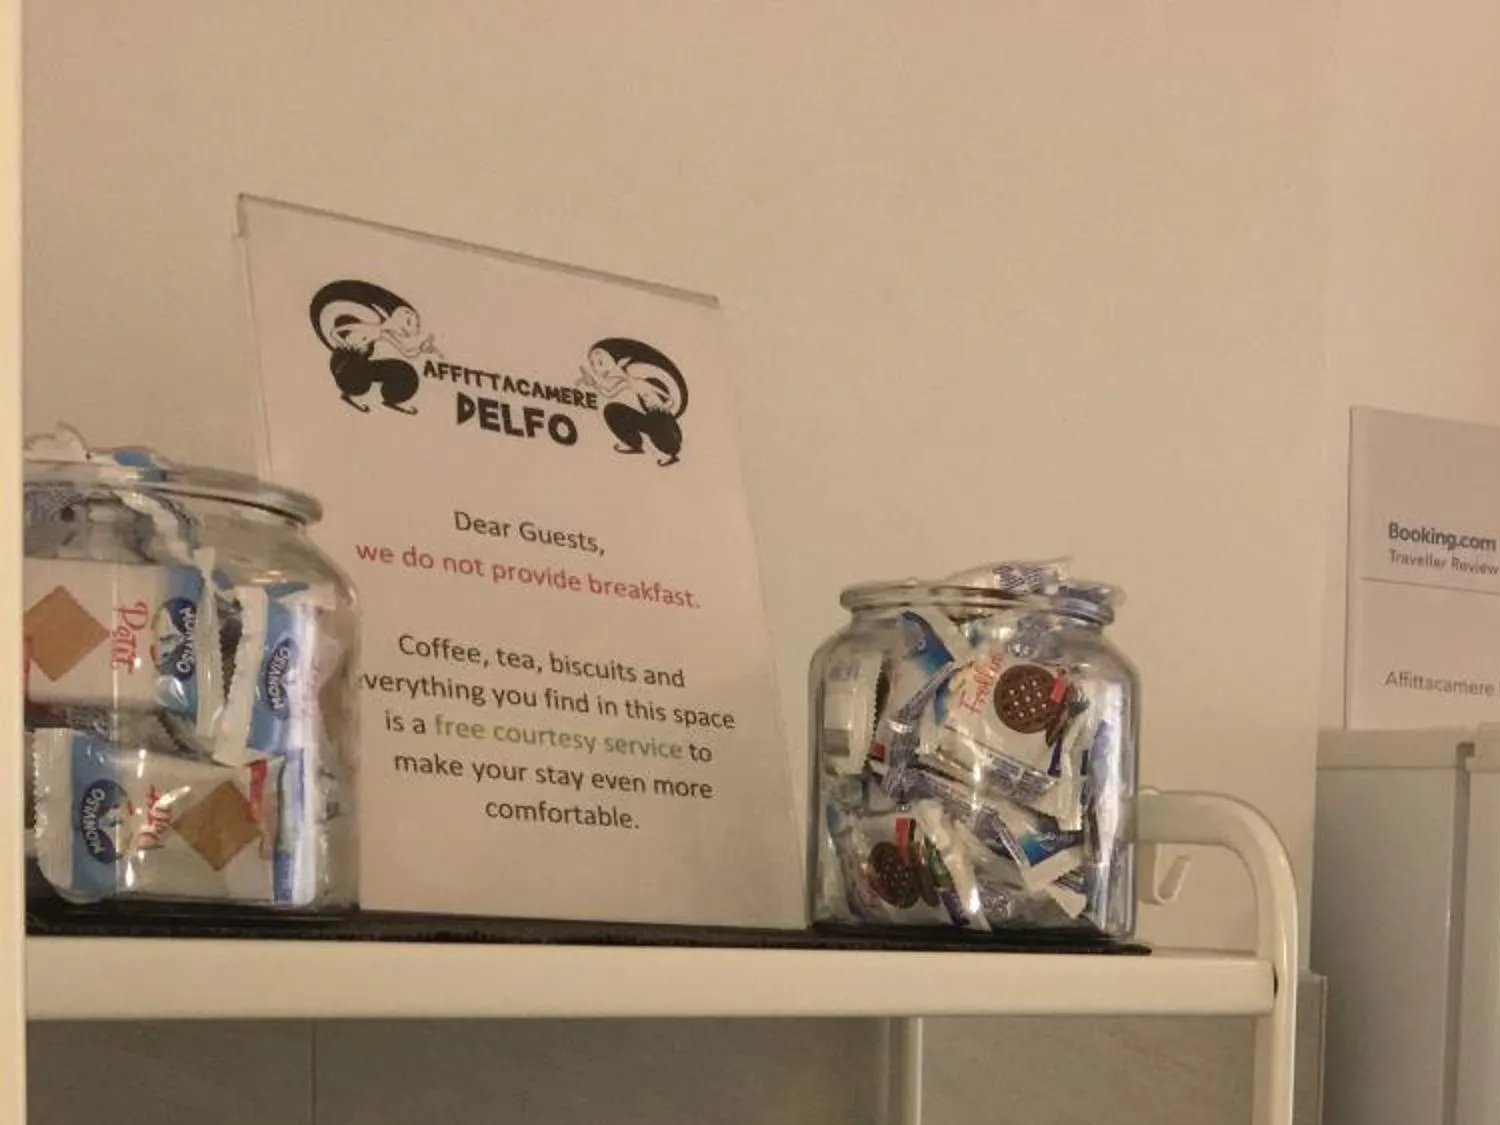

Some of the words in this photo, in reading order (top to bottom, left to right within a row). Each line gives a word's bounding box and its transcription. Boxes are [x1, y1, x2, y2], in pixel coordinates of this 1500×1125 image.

[423, 359, 599, 411] AFFITTACAMERE
[455, 392, 579, 447] DELFO
[453, 510, 511, 539] Dear
[519, 521, 606, 556] Guests,
[1388, 521, 1498, 553] Booking.com
[355, 543, 395, 564] we
[402, 545, 434, 571] do
[443, 554, 486, 579] not
[493, 561, 581, 593] provide
[588, 573, 701, 609] breakfast.
[1389, 548, 1447, 570] Traveller
[1451, 557, 1499, 576] Review
[399, 633, 490, 668] Coffee,
[496, 646, 544, 675] tea,
[549, 651, 637, 684] biscuits
[644, 669, 686, 690] and
[1384, 671, 1495, 697] Affittacamere
[359, 673, 487, 708] verything
[492, 687, 538, 709] you
[544, 687, 590, 715] find
[598, 695, 619, 717] in
[625, 699, 667, 722] this
[673, 707, 736, 736] space
[384, 709, 405, 733] is
[412, 717, 427, 735] a
[434, 713, 486, 740] free
[493, 724, 598, 755] courtesy
[604, 736, 684, 760] service
[689, 742, 713, 763] to
[394, 752, 464, 777] make
[472, 762, 527, 784] your
[536, 765, 583, 791] stay
[591, 775, 646, 794] even
[654, 779, 714, 799] more
[485, 798, 641, 831] comfortable.
